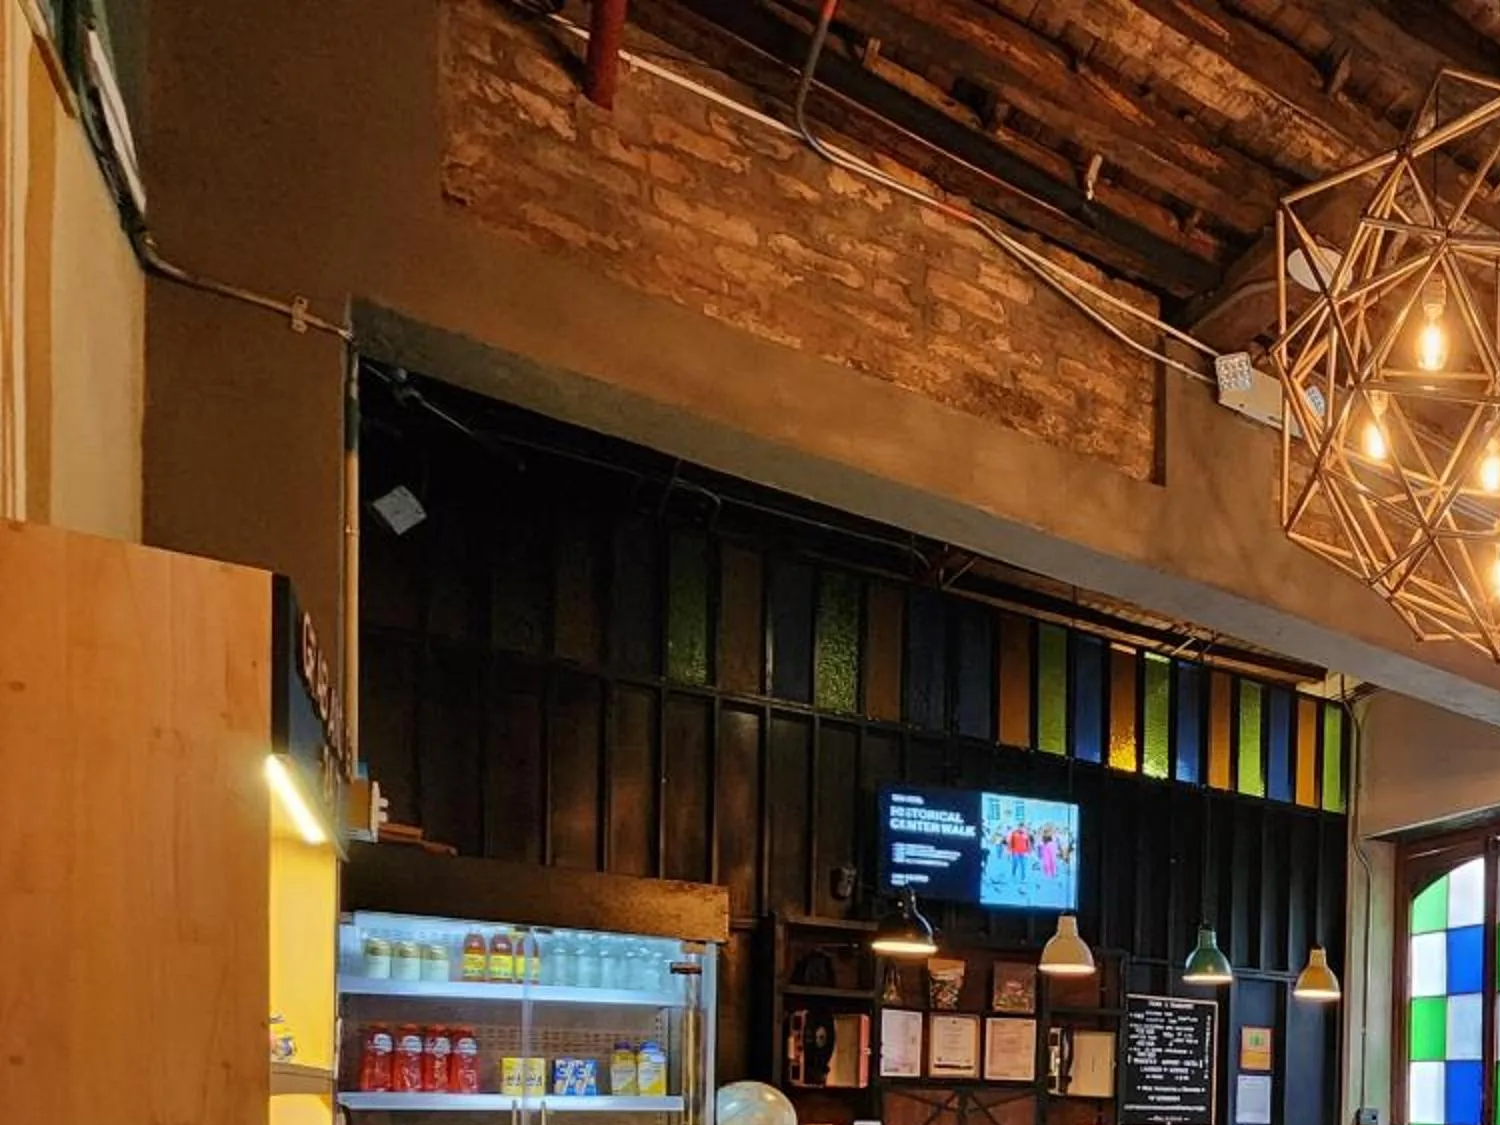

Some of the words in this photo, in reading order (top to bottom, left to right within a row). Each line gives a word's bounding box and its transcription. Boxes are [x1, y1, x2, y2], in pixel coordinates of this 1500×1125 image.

[889, 805, 964, 823] HISTORICAL
[889, 818, 941, 833] CENTER
[942, 824, 977, 837] WALK
